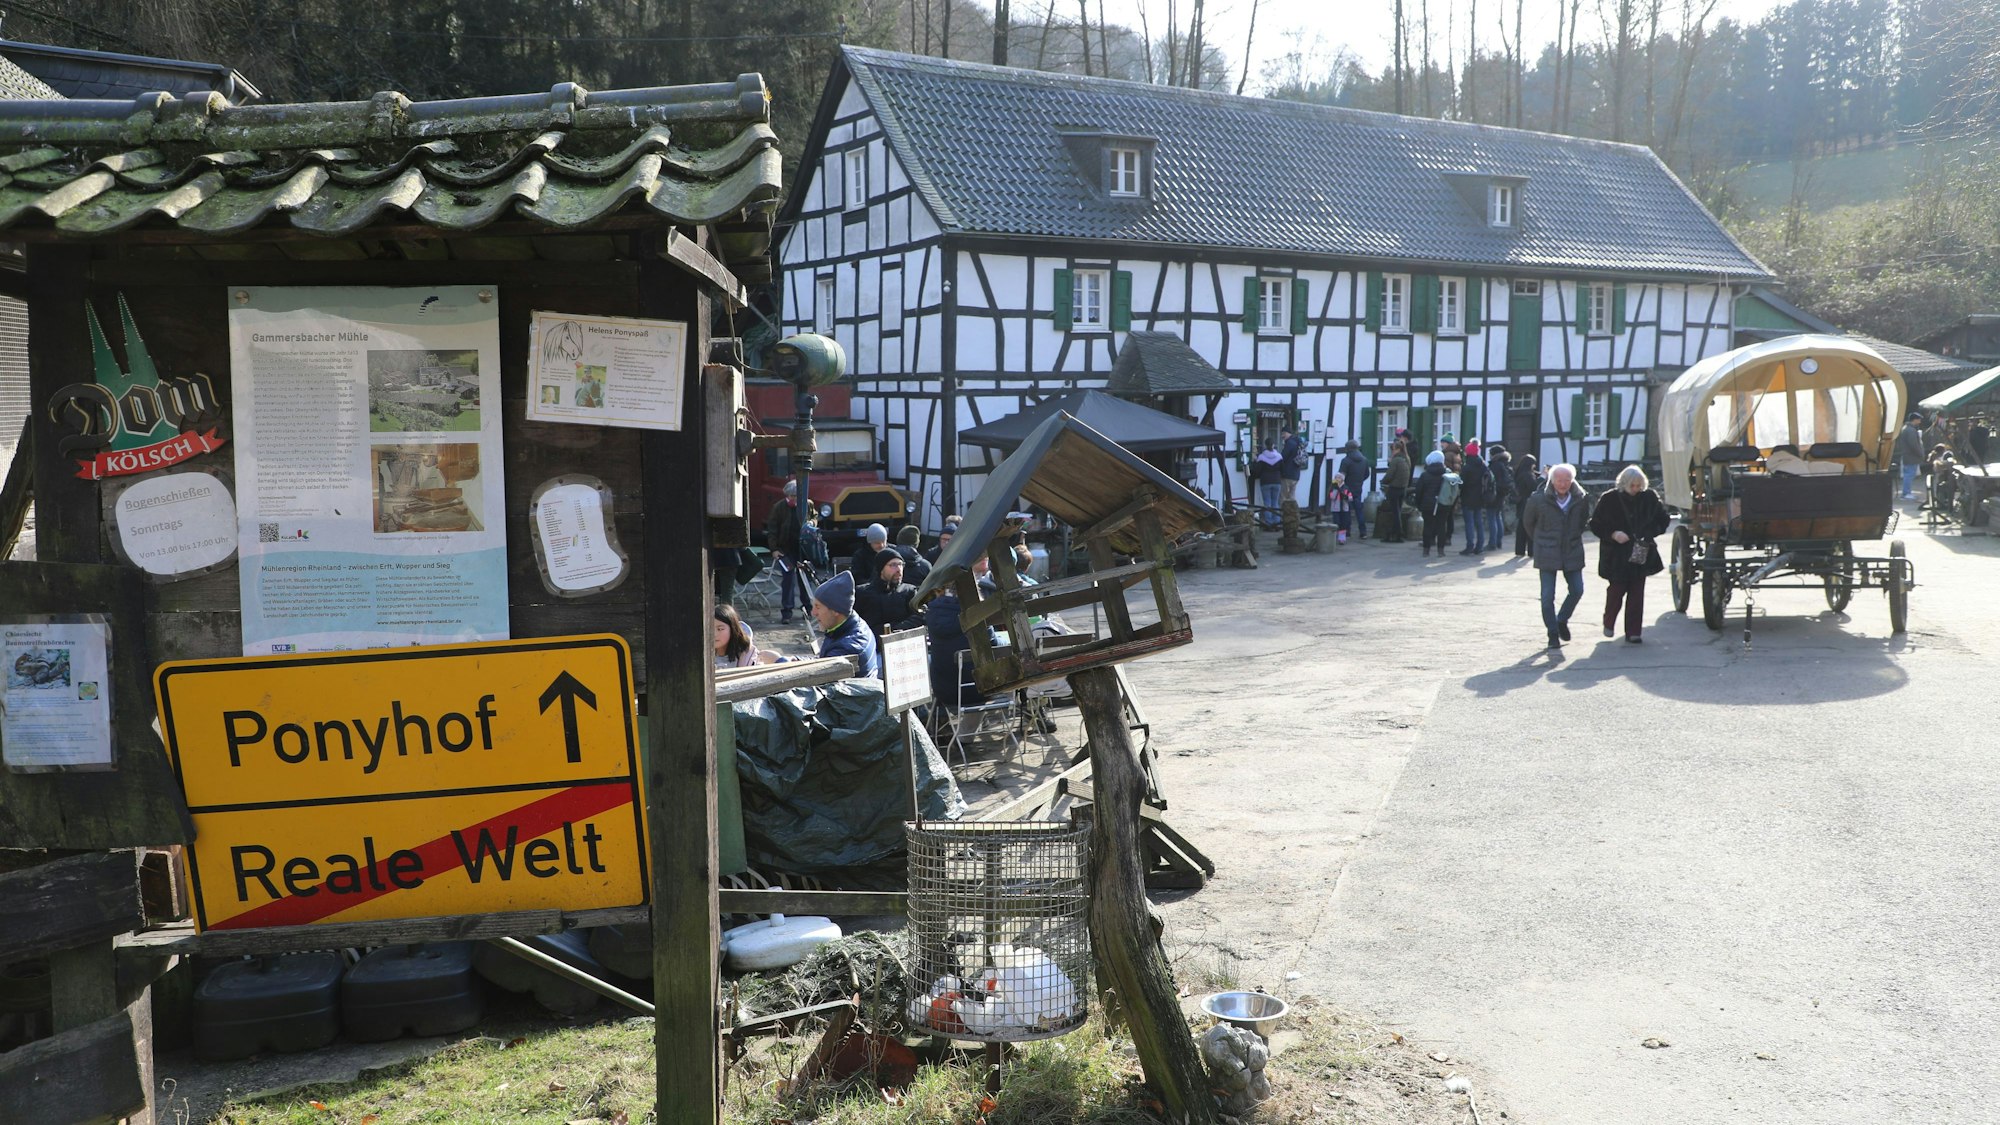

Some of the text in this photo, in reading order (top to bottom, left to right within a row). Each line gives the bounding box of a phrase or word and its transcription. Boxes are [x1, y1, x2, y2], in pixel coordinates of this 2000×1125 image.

[252, 332, 369, 342] Gammersbacher Mühle
[588, 326, 649, 338] Helens Ponyspaß
[48, 371, 222, 458] Dom
[107, 438, 193, 472] KÖLSCH
[125, 487, 211, 511] Bogenschießen
[130, 519, 184, 536] Sonntags
[139, 551, 155, 559] Von
[156, 546, 178, 556] 13.00
[192, 541, 214, 549] 17:00
[214, 536, 230, 545] Uhr
[395, 563, 420, 571] Wupper
[436, 562, 451, 571] Sieg
[223, 694, 497, 774] Ponyhof
[230, 821, 606, 902] Reale Welt
